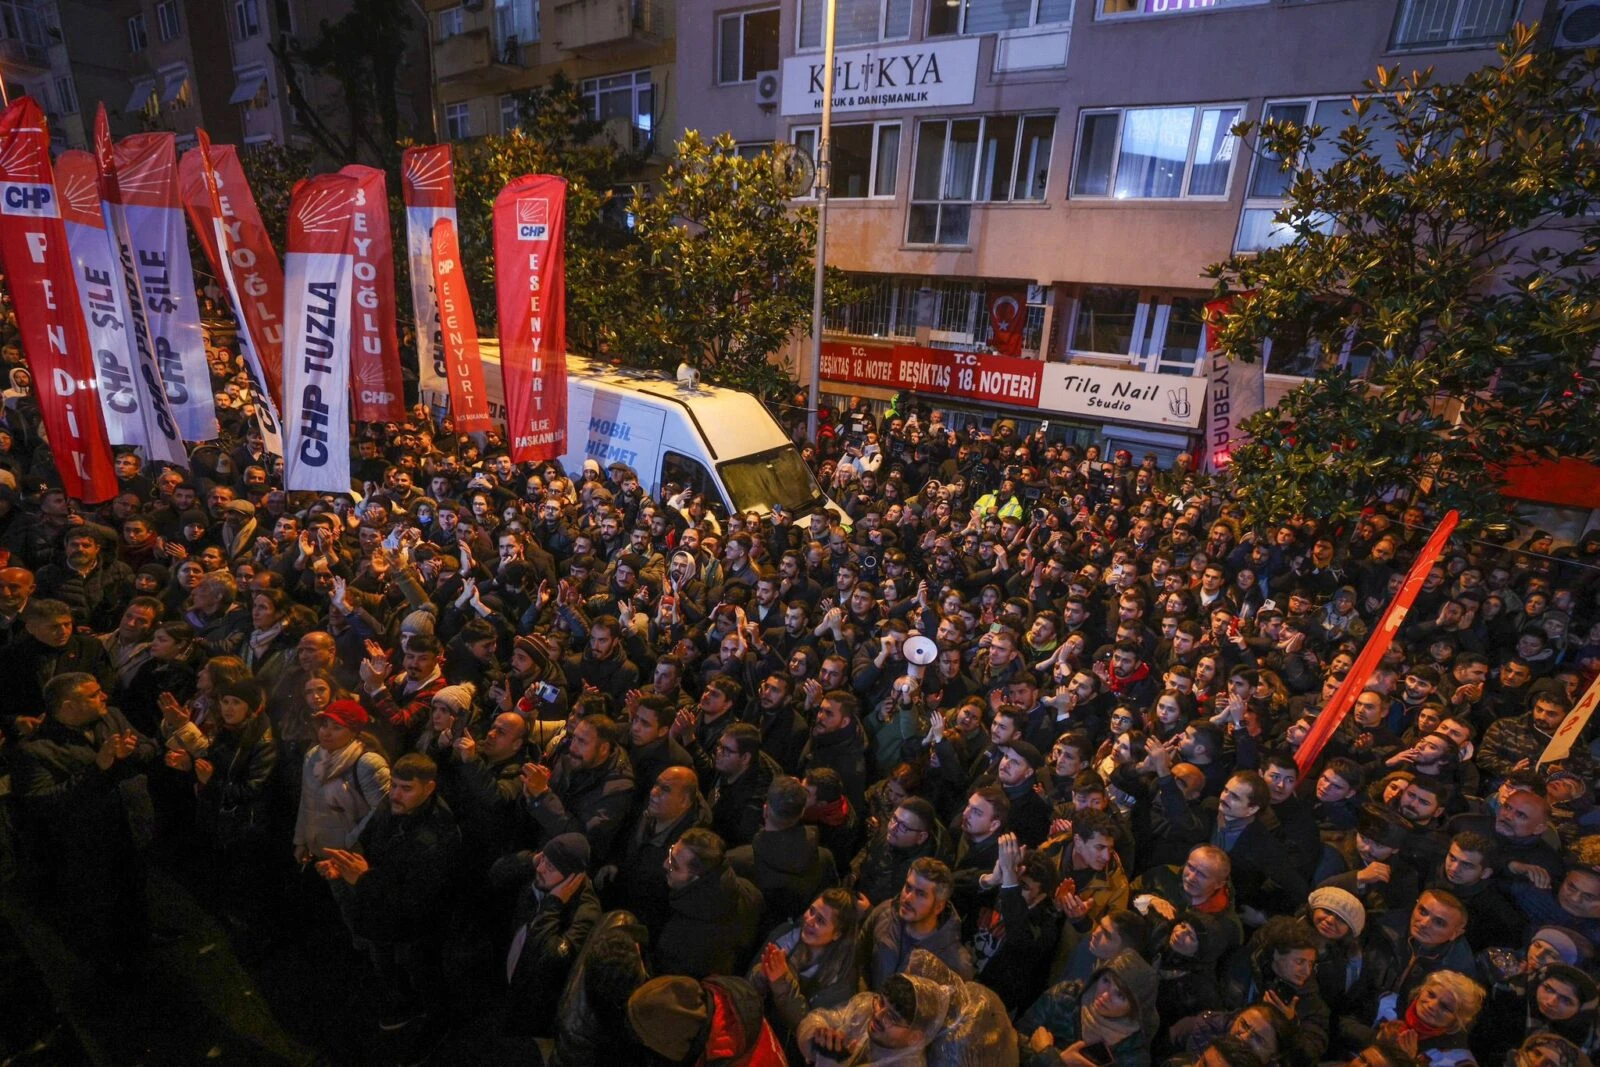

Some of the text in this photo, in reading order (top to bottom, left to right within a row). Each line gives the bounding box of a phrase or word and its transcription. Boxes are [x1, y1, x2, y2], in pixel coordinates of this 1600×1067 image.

[849, 97, 855, 106] &
[858, 92, 928, 106] DANIŞMANLIK
[5, 186, 51, 209] CHP
[520, 226, 546, 237] CHP
[438, 259, 454, 275] CHP
[139, 249, 188, 405] CHP ŞİLE
[529, 254, 543, 411] ESENYURT
[85, 266, 138, 414] CHP ŞİLE
[443, 282, 474, 408] ESENYURT
[851, 346, 867, 357] T.C.
[25, 232, 91, 480] PENDİK
[954, 353, 981, 366] T.C.
[300, 282, 337, 467] CHP TUZLA
[853, 362, 864, 377] 18.
[899, 358, 1037, 399] BEŞİKTAŞ 18. NOTERİ
[361, 390, 396, 405] CHP
[1064, 376, 1160, 401] Tila Nail
[1087, 396, 1131, 411] Studio
[588, 417, 631, 441] MOBİL
[584, 440, 638, 466] HİZMET
